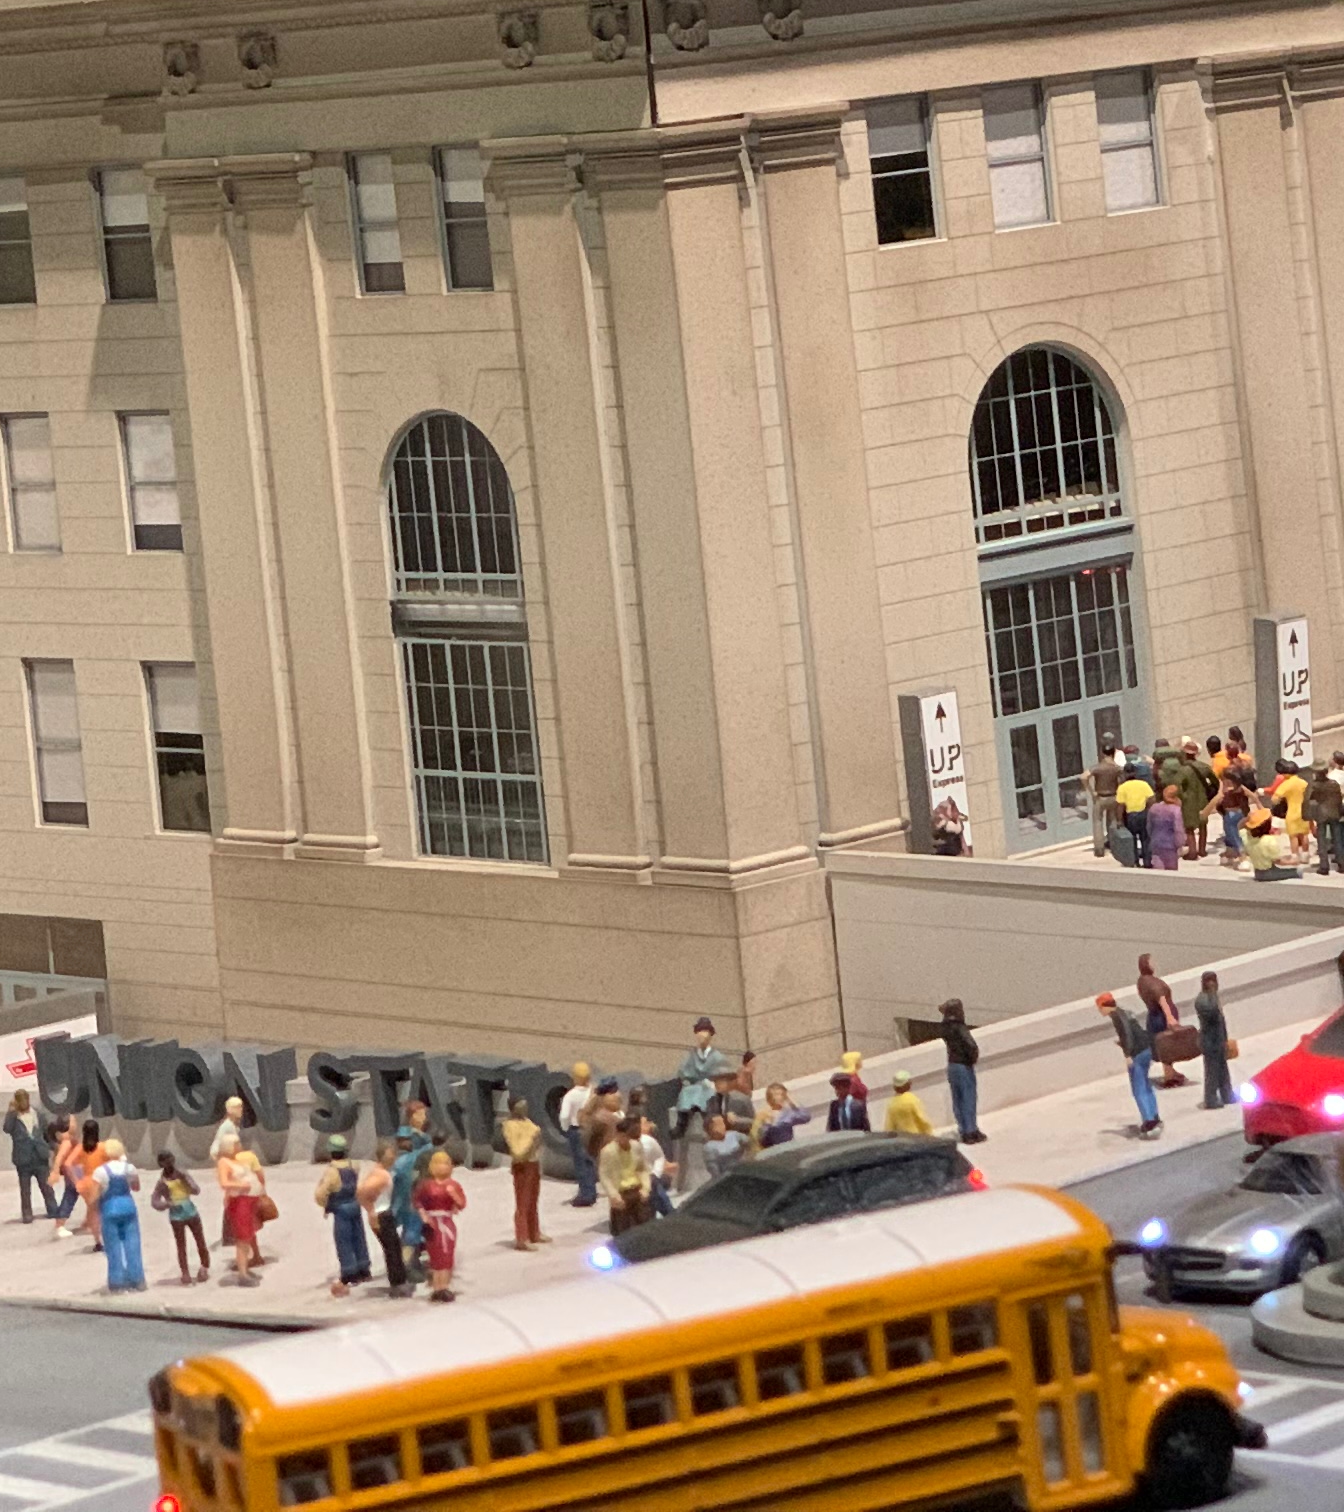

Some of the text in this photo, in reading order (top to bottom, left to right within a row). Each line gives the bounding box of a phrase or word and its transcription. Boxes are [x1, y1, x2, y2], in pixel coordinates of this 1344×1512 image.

[1282, 668, 1309, 696] UP
[929, 744, 961, 774] UP
[33, 1033, 298, 1132] UNION
